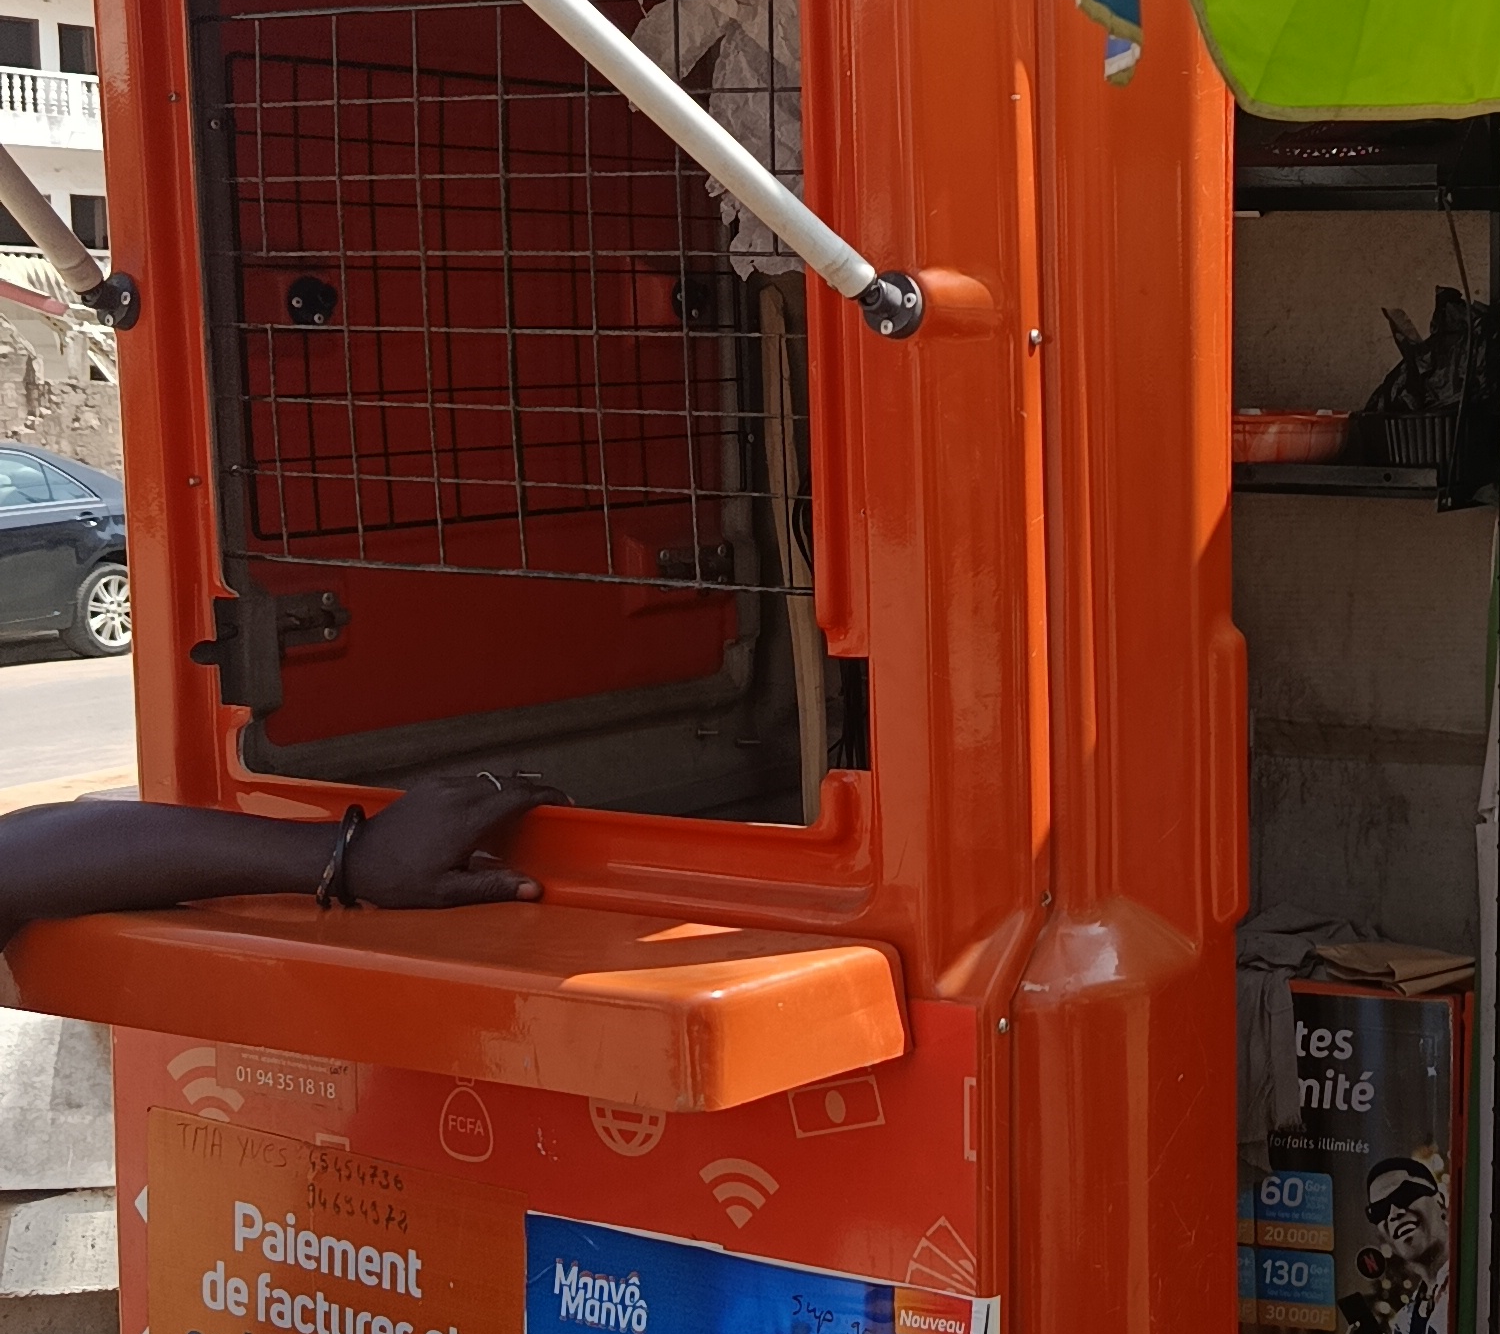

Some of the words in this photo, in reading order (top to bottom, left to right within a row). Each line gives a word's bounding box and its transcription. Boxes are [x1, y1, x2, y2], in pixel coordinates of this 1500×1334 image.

[236, 1065, 251, 1083] 01
[256, 1069, 274, 1087] 94
[277, 1073, 294, 1091] 35
[298, 1077, 315, 1095] 18
[318, 1081, 336, 1099] 18
[447, 1114, 485, 1137] FCFA
[1260, 1176, 1304, 1207] 60
[234, 1200, 422, 1298] Paiement
[202, 1261, 249, 1317] de
[553, 1258, 641, 1307] Manvô
[1262, 1259, 1309, 1288] 130
[899, 1309, 966, 1334] Nouveau
